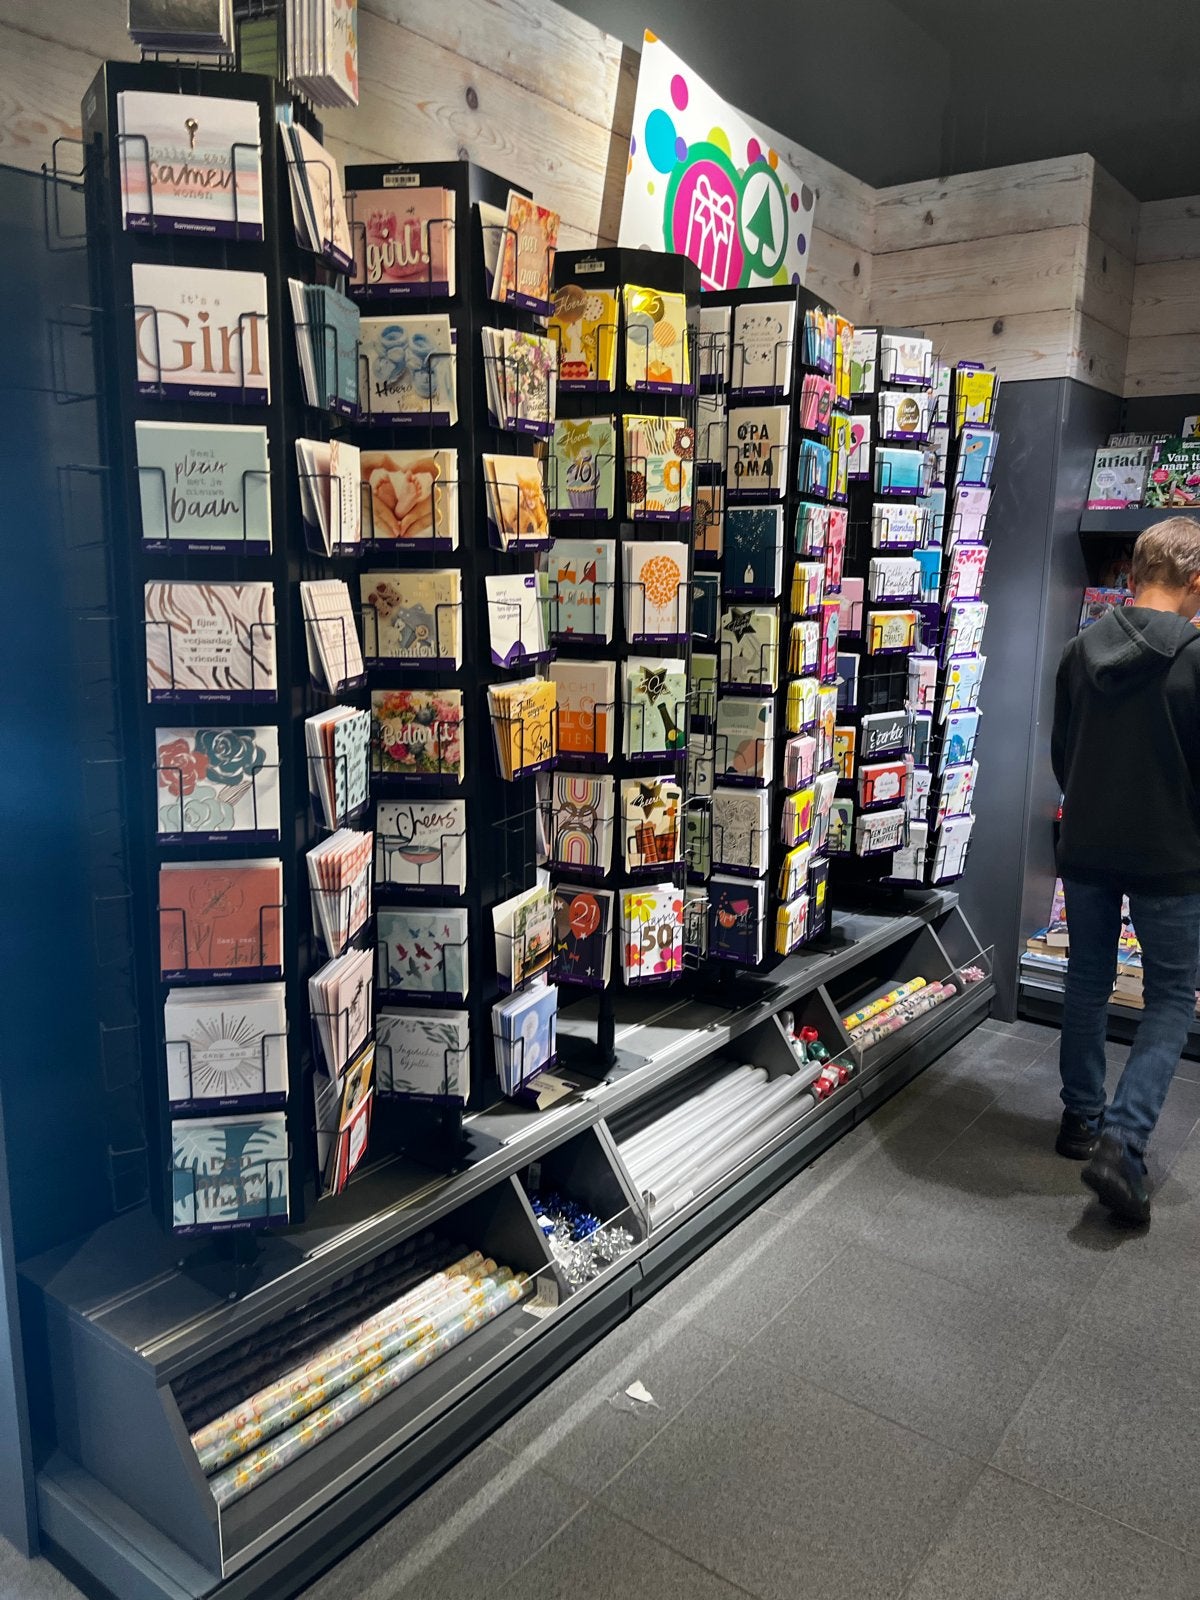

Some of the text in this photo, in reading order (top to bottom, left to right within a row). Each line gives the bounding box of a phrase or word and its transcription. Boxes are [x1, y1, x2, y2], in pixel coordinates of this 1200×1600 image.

[136, 309, 264, 376] Girl
[737, 422, 769, 441] OPA
[743, 441, 762, 459] EN
[1167, 453, 1189, 462] Van
[1161, 462, 1189, 472] naar
[171, 487, 240, 524] baan
[559, 682, 596, 692] ACHT
[396, 806, 455, 844] Cheers
[571, 901, 597, 929] 21
[640, 923, 674, 952] 50
